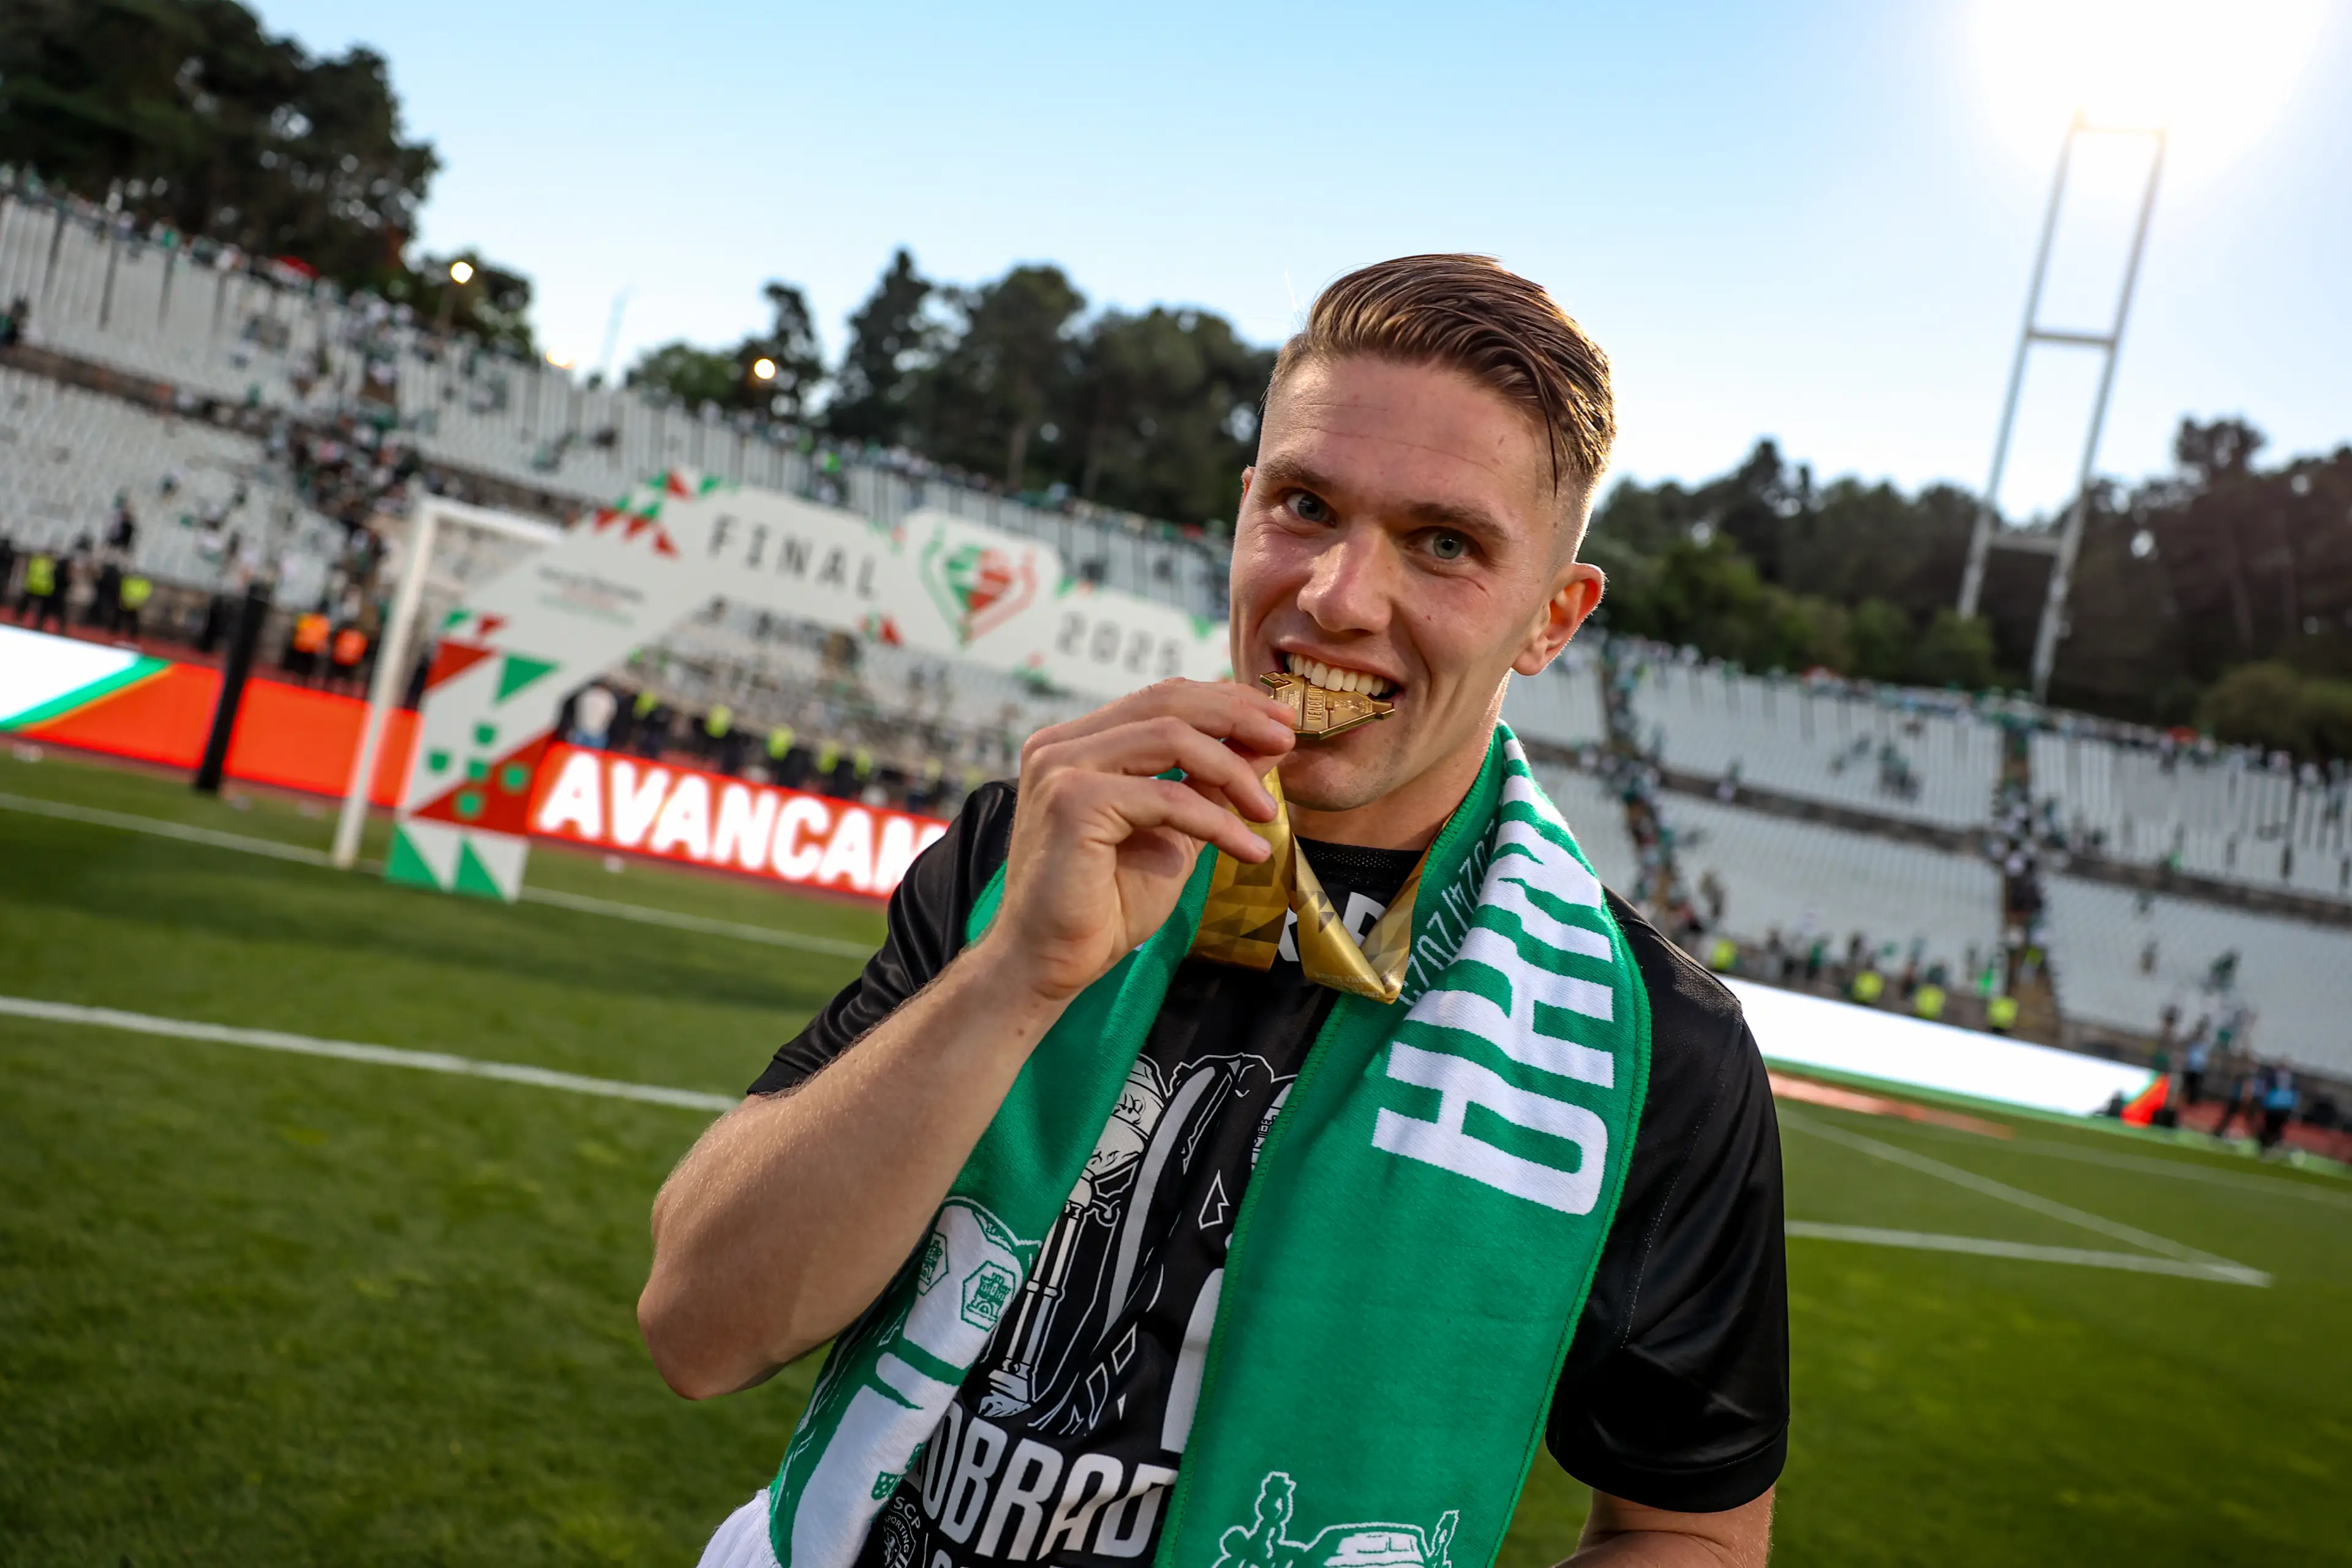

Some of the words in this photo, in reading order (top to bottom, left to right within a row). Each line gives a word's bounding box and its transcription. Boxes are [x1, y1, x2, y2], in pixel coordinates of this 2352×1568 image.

[706, 514, 881, 601] FINAL
[1054, 611, 1185, 678] 2025
[1306, 687, 1324, 721] VENCEDO
[1372, 718, 1614, 1216] INHA
[893, 1496, 921, 1529] SCP
[904, 1403, 1177, 1561] OBRAD
